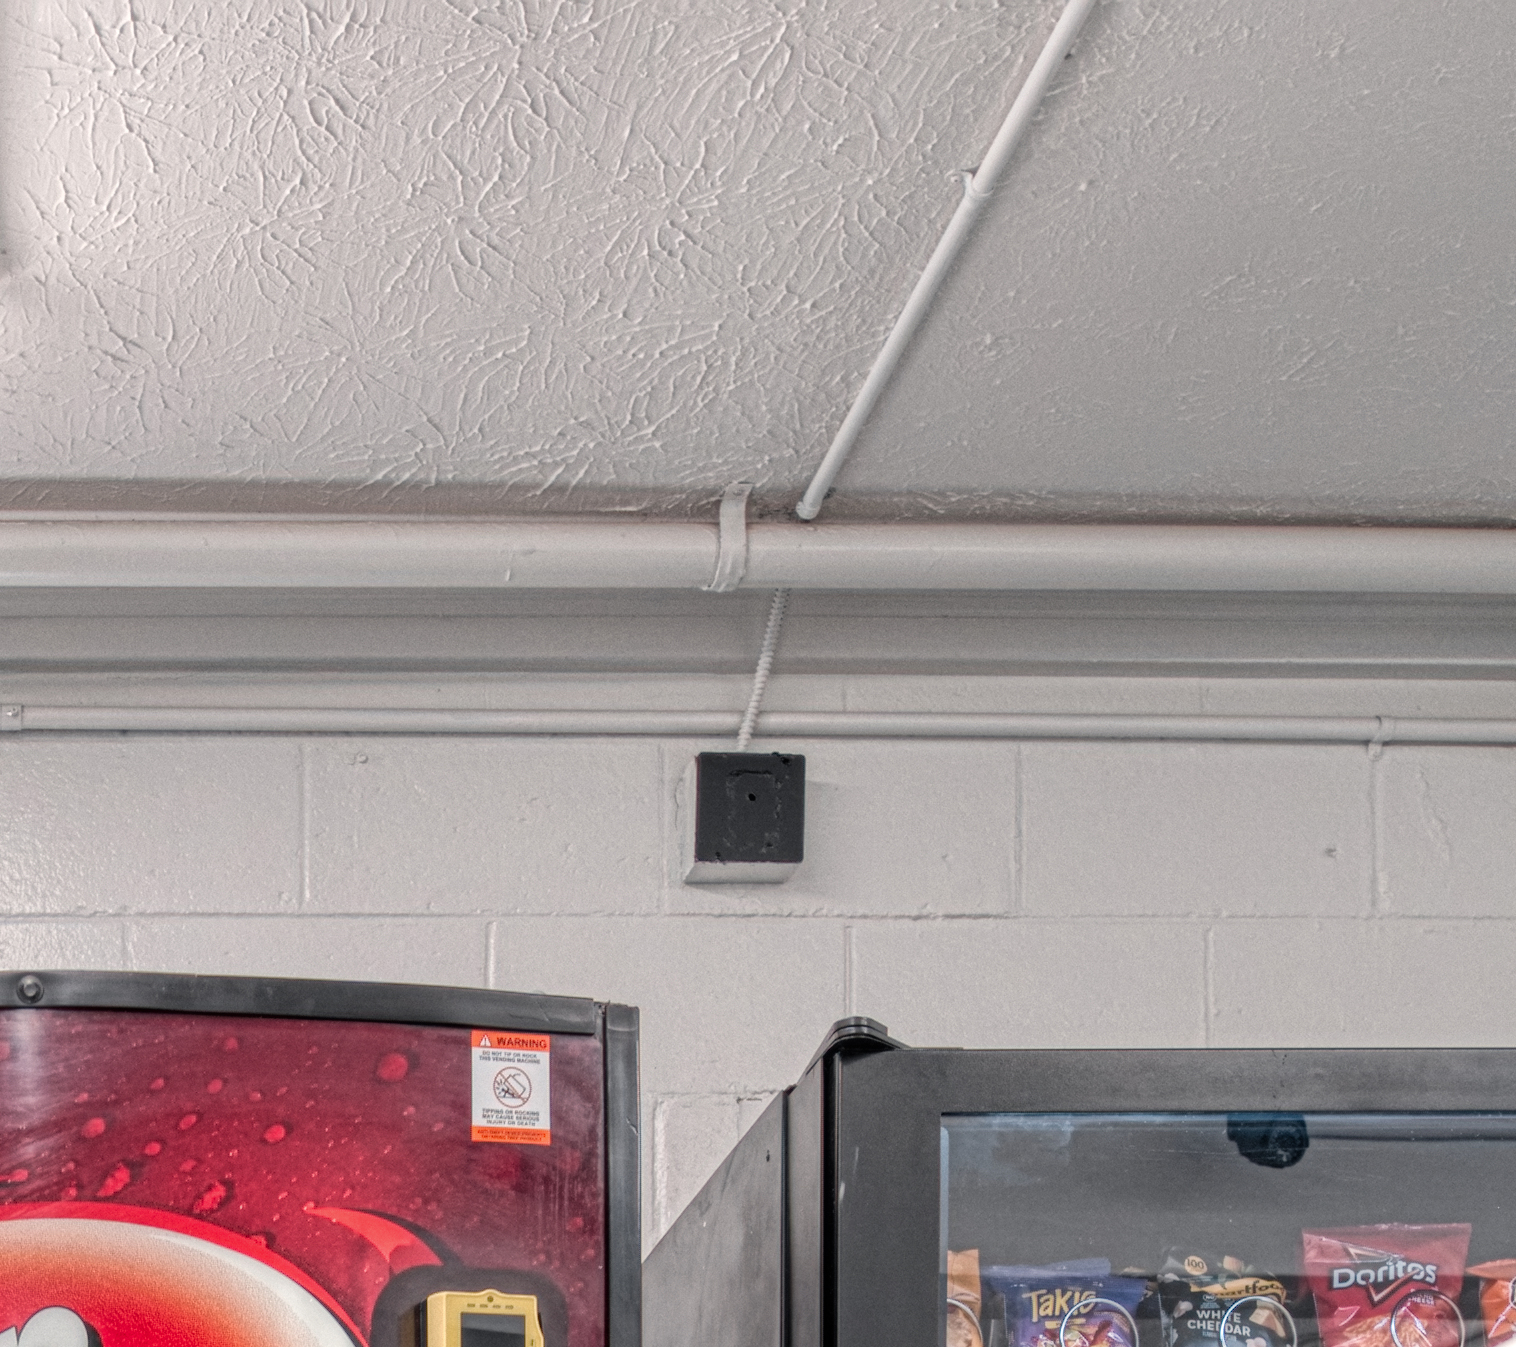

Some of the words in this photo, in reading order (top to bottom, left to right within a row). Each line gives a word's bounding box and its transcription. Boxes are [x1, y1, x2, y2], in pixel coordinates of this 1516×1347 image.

[496, 1037, 547, 1048] WARNING
[1332, 1258, 1437, 1289] Doritos
[1022, 1288, 1097, 1323] Takis
